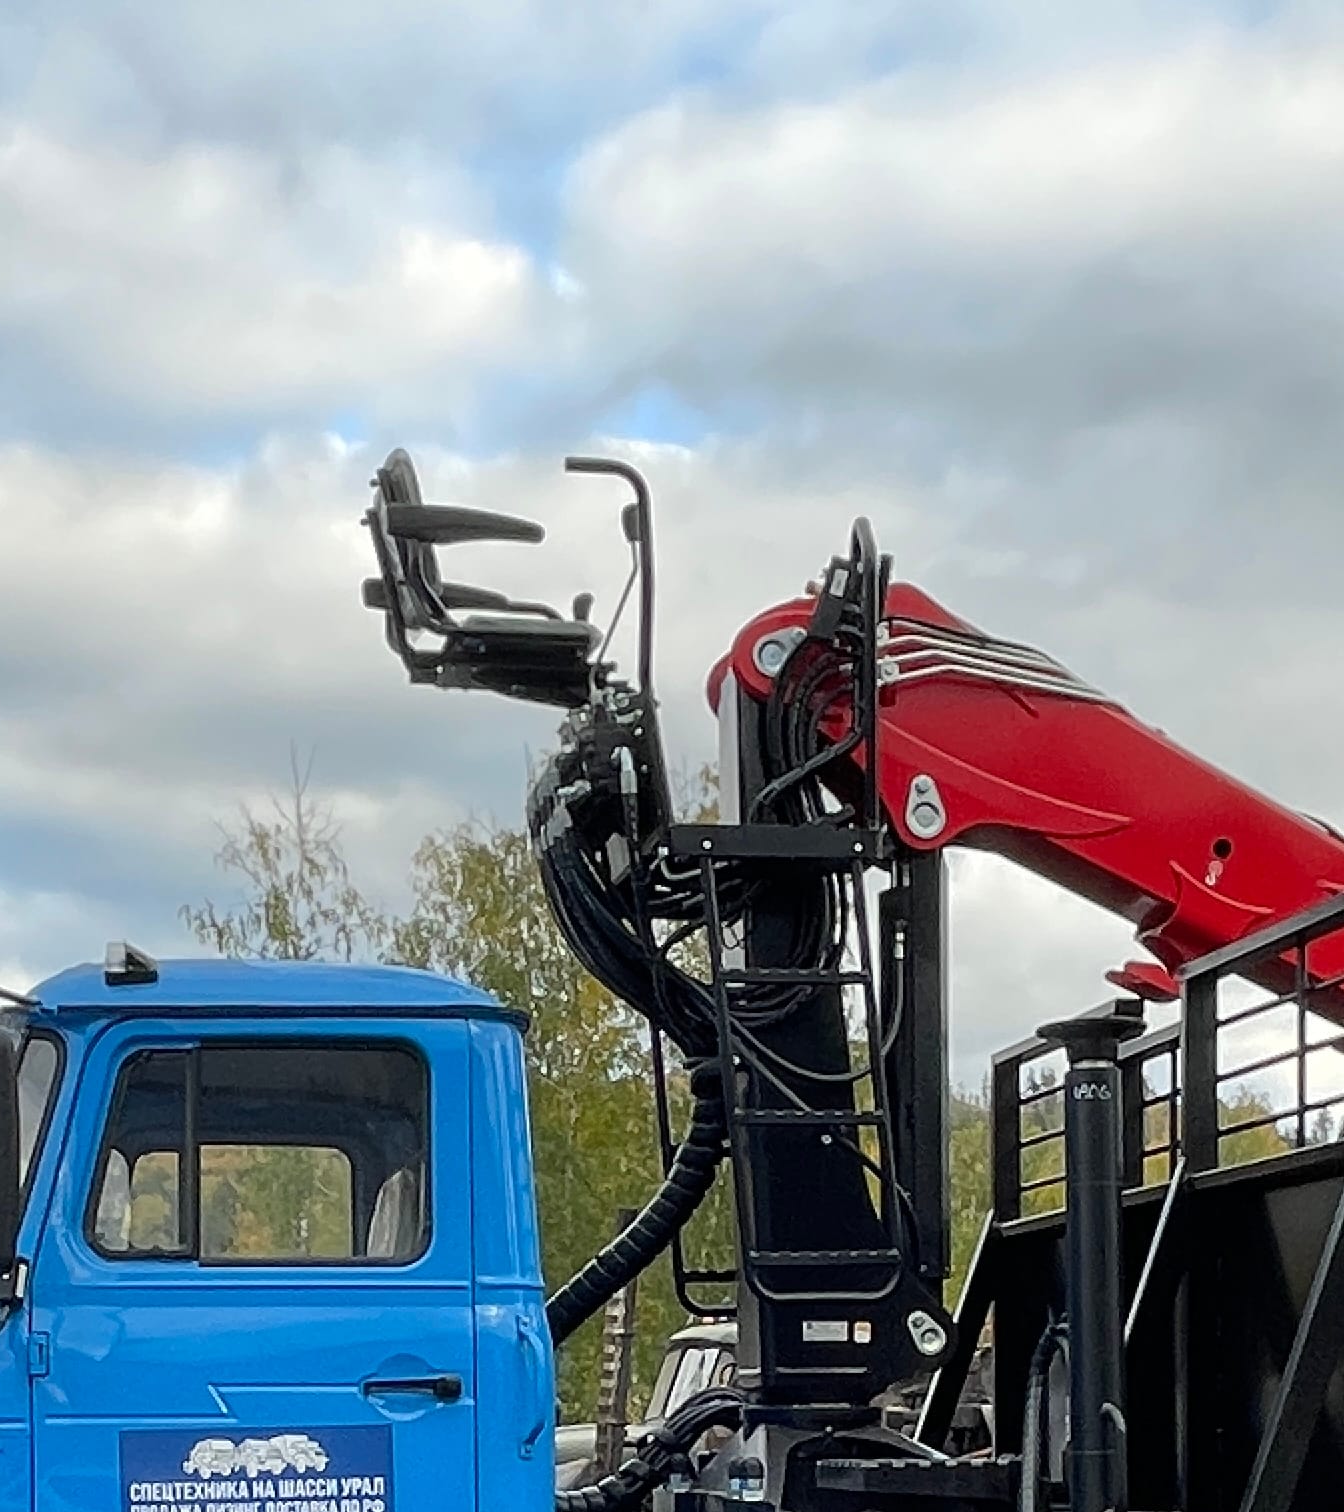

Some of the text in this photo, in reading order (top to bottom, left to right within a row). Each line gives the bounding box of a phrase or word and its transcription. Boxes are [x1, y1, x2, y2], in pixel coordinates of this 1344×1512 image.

[130, 1476, 384, 1502] СПЕЦТЕХНИКА НА ШАССИ УРАЛ
